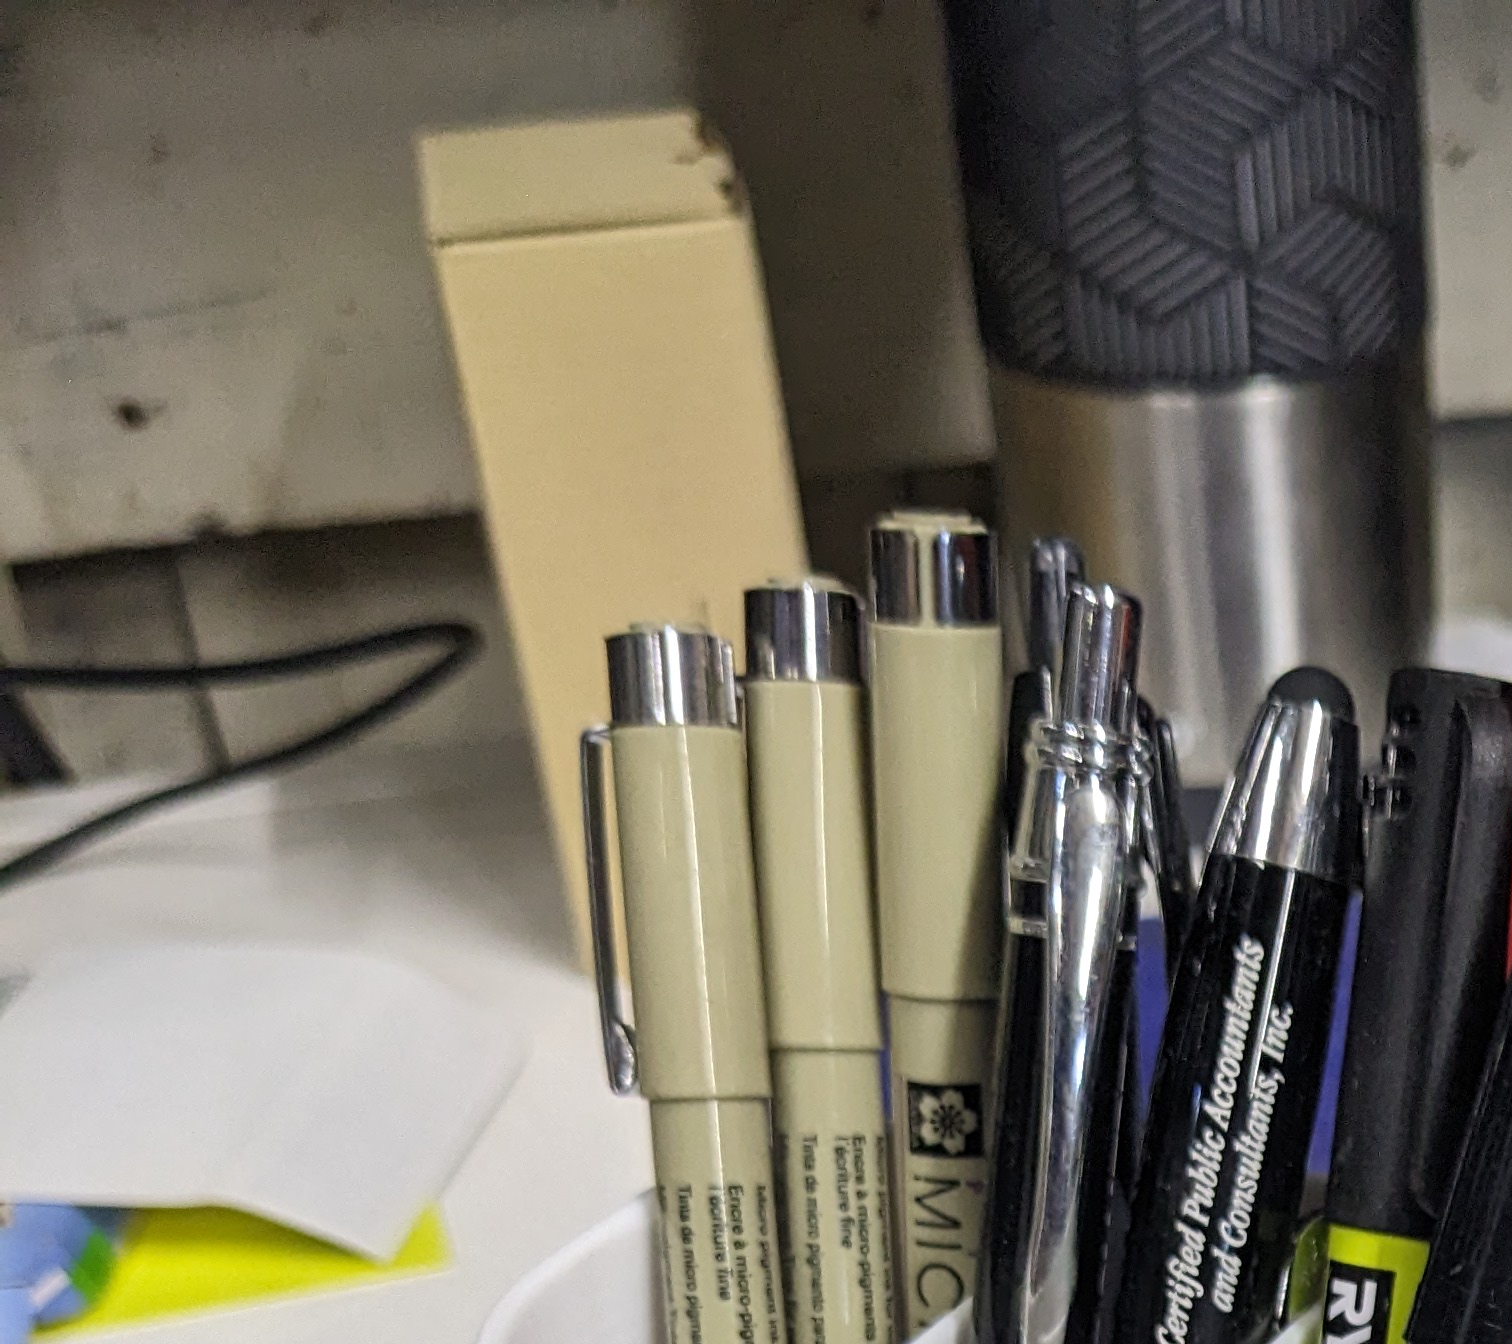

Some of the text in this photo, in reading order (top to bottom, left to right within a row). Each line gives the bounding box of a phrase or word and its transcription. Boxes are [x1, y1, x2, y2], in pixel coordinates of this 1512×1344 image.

[1202, 932, 1264, 1132] Accountants
[852, 1134, 866, 1184] Encre
[1182, 1128, 1226, 1227] Public
[1212, 1002, 1294, 1313] and Consultants, Inc.
[678, 1185, 693, 1223] Tinta
[806, 1175, 818, 1193] de
[681, 1226, 694, 1245] de
[728, 1185, 744, 1236] Encre
[806, 1198, 821, 1239] micro
[841, 1217, 855, 1248] fine
[684, 1250, 698, 1293] micro
[914, 1174, 964, 1320] MIC
[718, 1267, 734, 1301] fine
[806, 1242, 824, 1314] pigmento
[858, 1205, 876, 1341] micro-pigments
